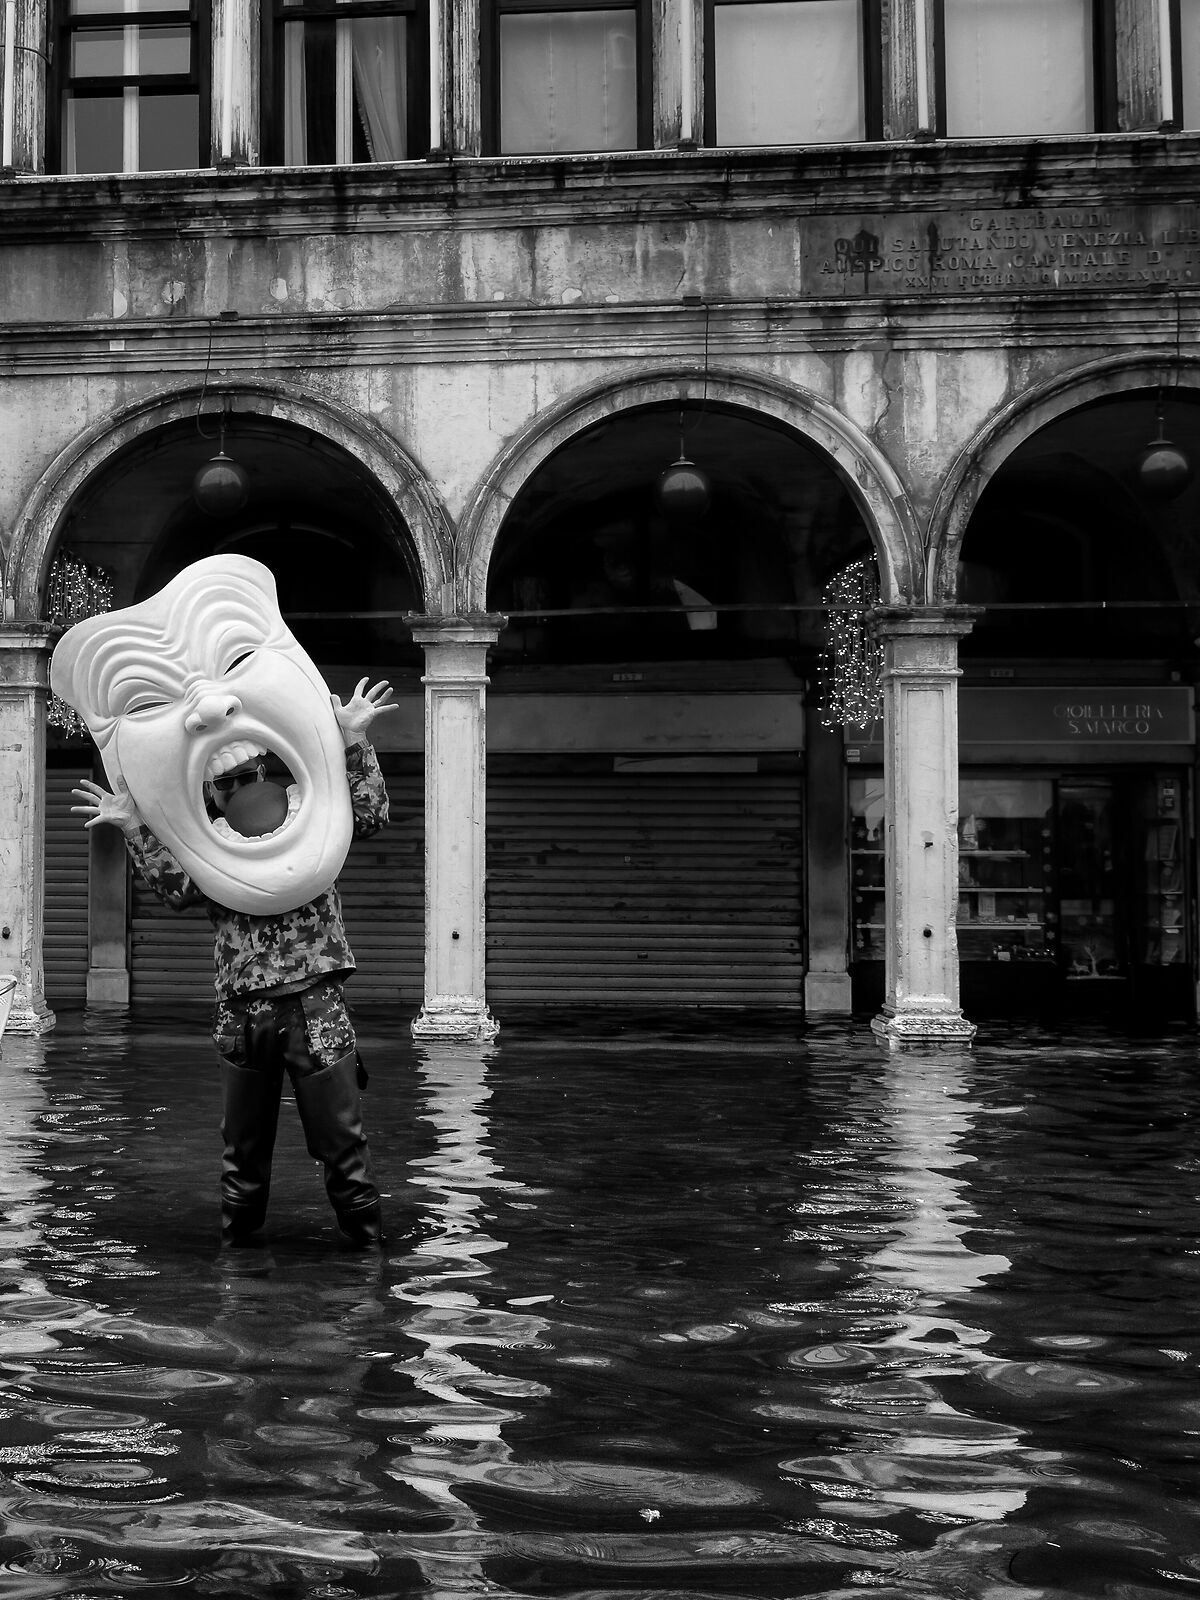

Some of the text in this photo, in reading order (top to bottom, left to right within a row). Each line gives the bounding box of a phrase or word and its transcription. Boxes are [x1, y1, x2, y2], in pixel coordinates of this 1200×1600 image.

[969, 213, 1112, 231] GARIBALDI
[836, 240, 877, 255] QUI
[892, 236, 1031, 253] SALUTANDO
[1044, 231, 1147, 249] VENEZIA
[933, 256, 999, 271] ROMA
[1011, 250, 1131, 269] CAPITALE
[905, 276, 950, 288] XXVI
[1052, 704, 1163, 719] GIOIELLERIA
[1067, 720, 1150, 735] S. MARCO
